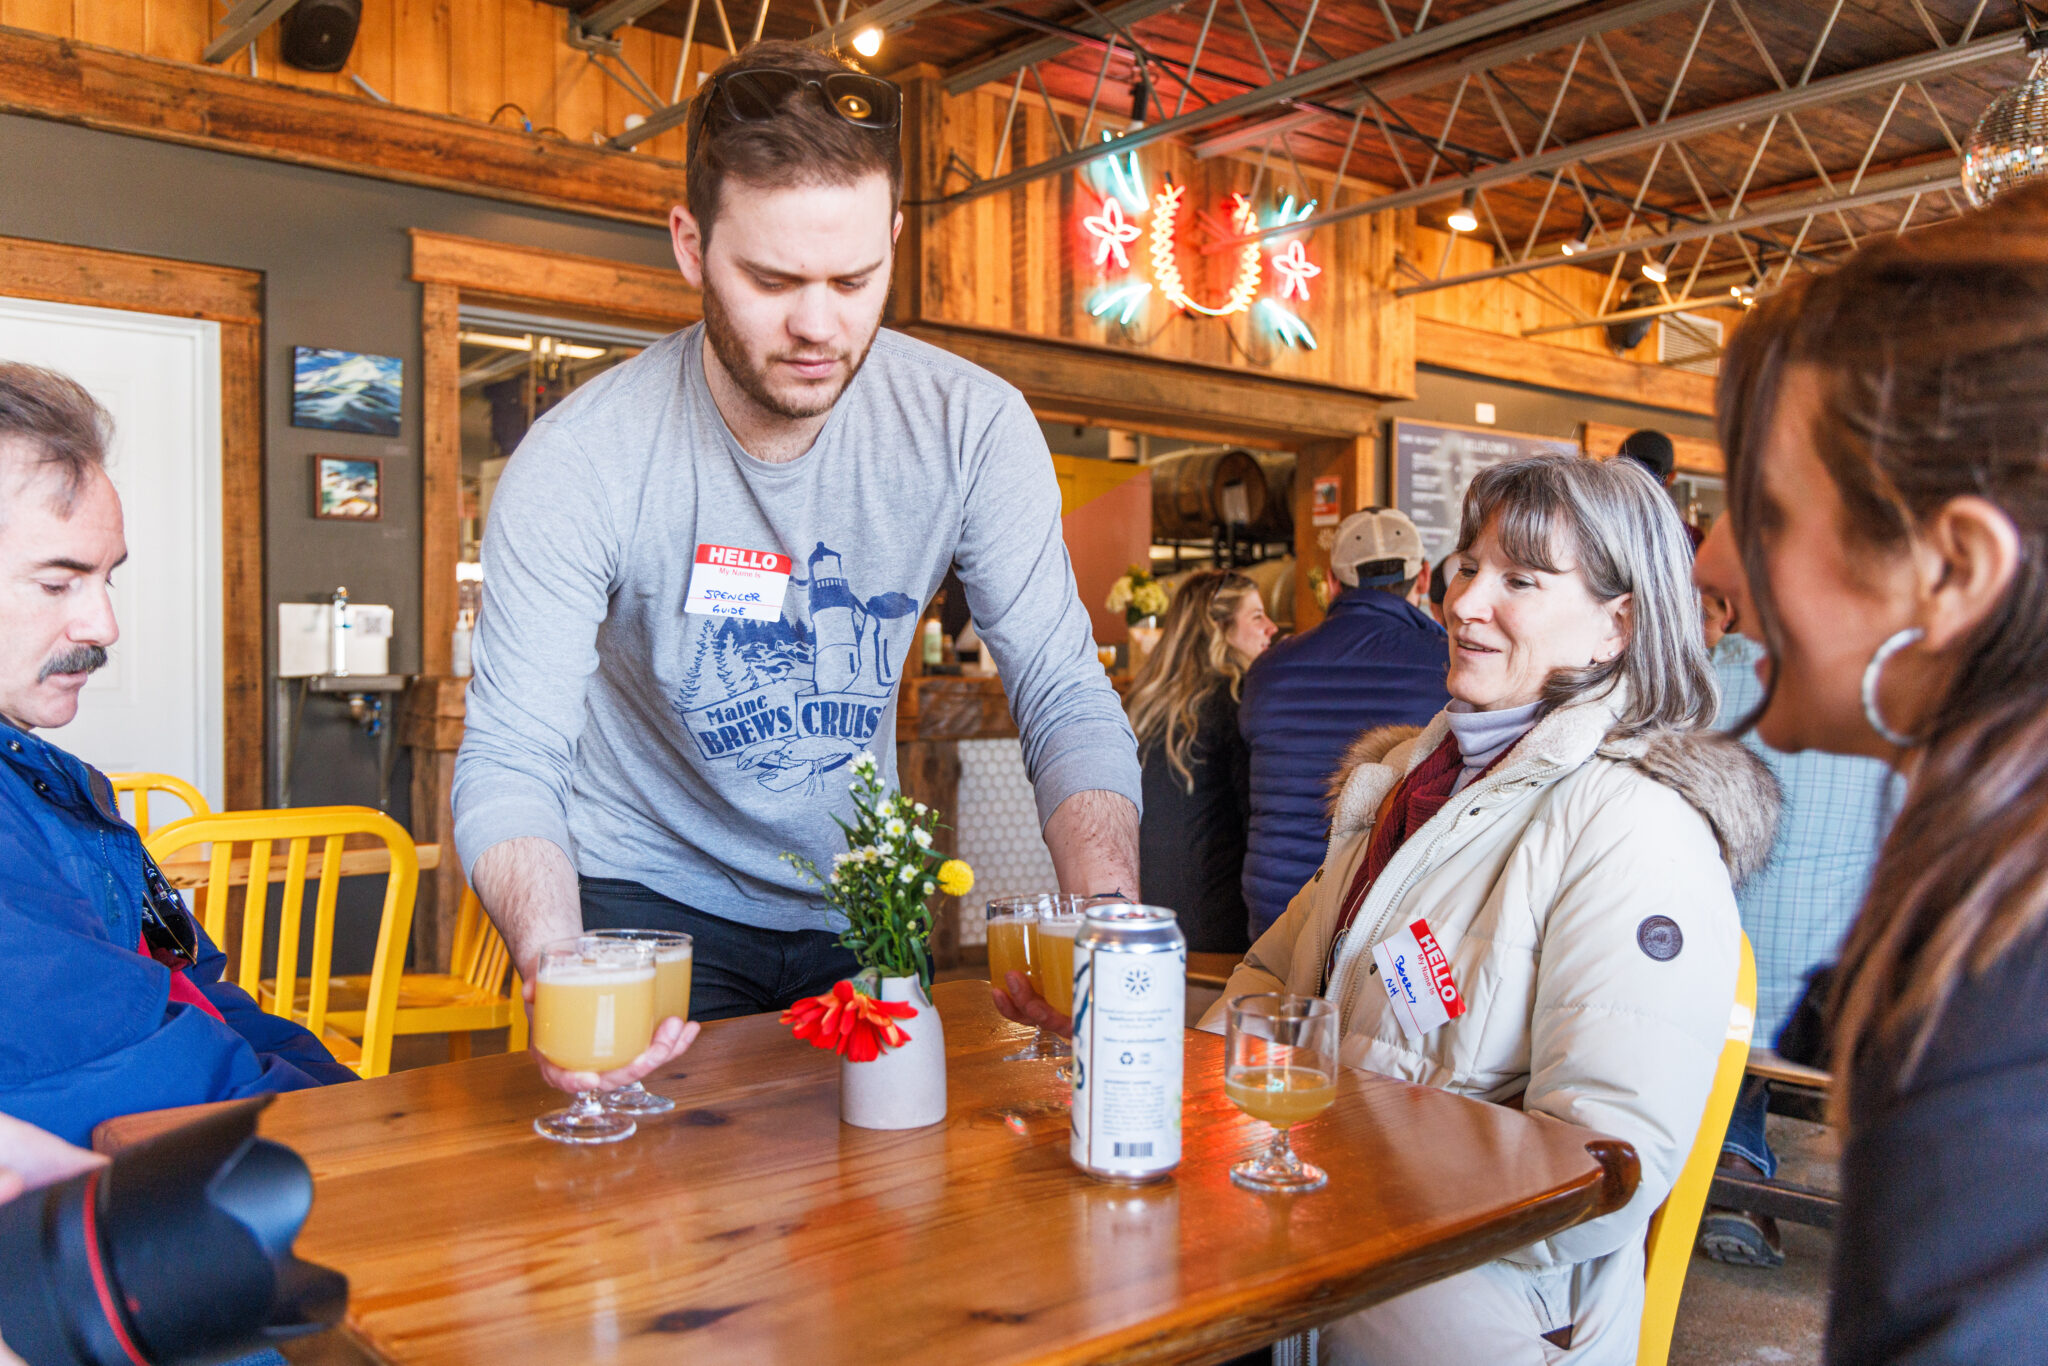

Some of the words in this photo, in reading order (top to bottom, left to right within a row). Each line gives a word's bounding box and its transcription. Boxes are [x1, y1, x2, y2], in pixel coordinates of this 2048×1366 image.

[708, 547, 778, 570] HELLO
[719, 567, 730, 577] My
[732, 569, 753, 578] Name
[703, 589, 762, 602] SPENCER
[712, 604, 747, 616] GUIDE
[705, 694, 768, 726] Maine
[698, 705, 793, 755] BREWS
[802, 701, 887, 739] CRUIS
[1417, 953, 1425, 965] My
[1421, 966, 1433, 987] Name
[1429, 987, 1436, 996] Is
[1419, 933, 1457, 1002] HELLO
[1385, 978, 1400, 998] NH
